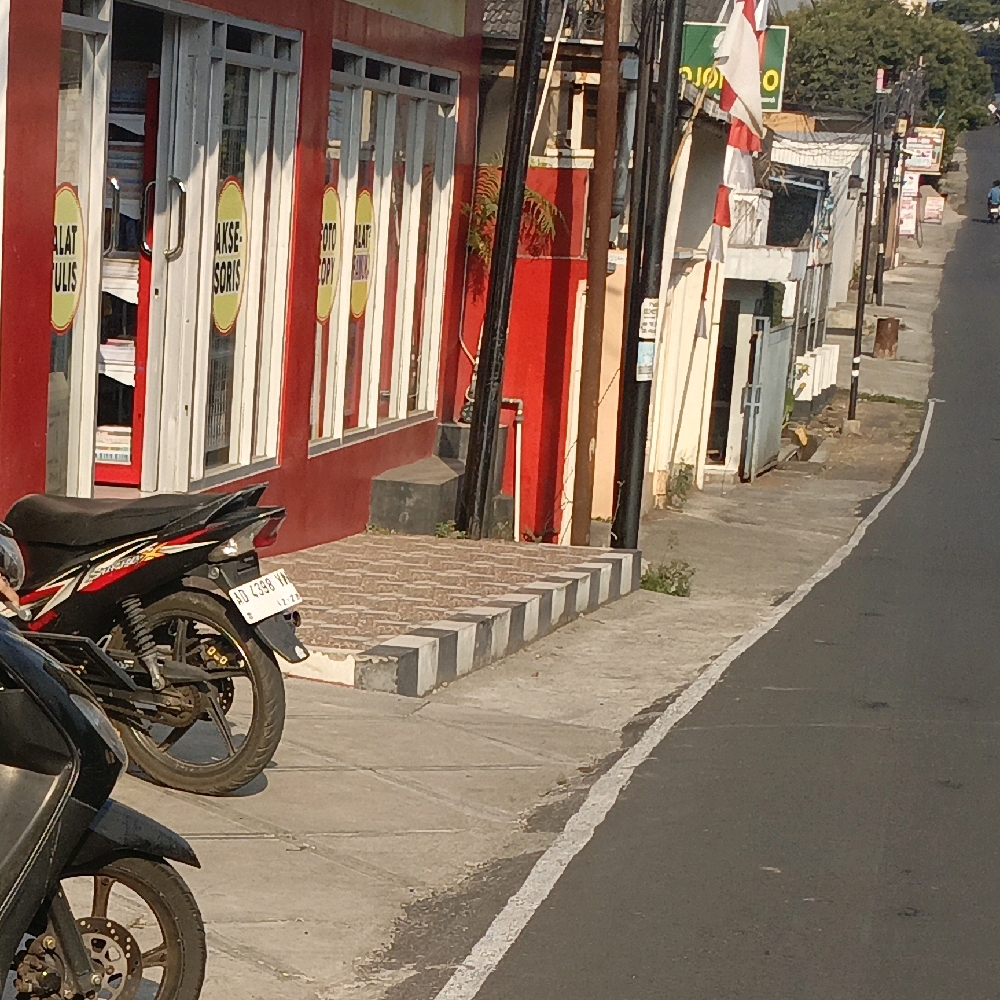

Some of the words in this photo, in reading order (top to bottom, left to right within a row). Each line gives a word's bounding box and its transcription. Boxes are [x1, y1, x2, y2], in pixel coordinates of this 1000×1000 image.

[320, 222, 337, 252] OTO
[52, 262, 77, 293] ULIS
[214, 259, 241, 294] SORIS
[319, 257, 336, 286] OPY
[233, 589, 250, 605] AD
